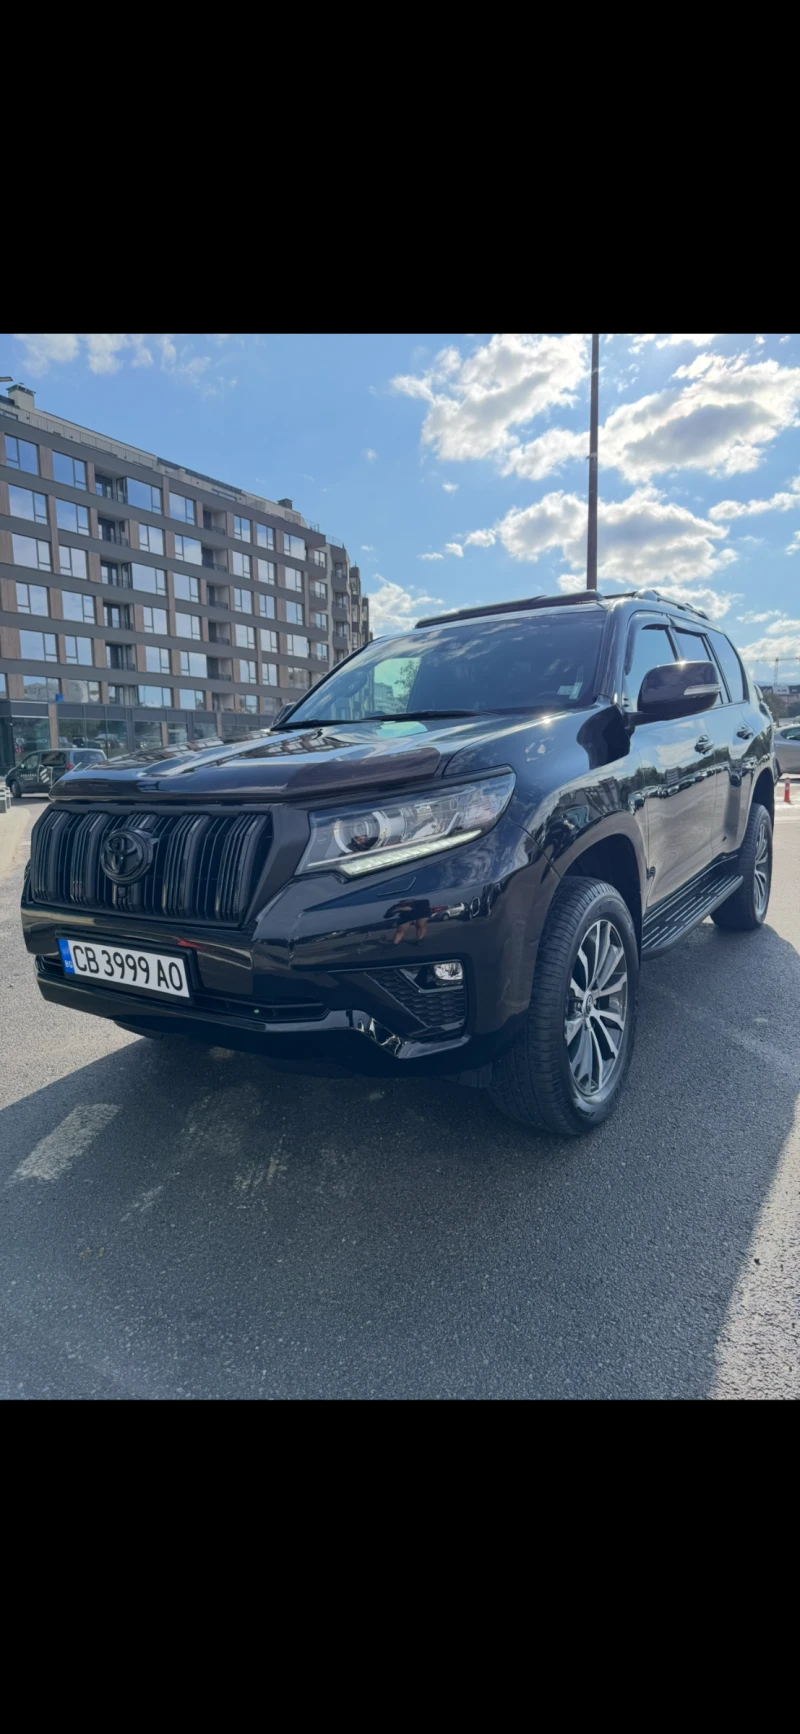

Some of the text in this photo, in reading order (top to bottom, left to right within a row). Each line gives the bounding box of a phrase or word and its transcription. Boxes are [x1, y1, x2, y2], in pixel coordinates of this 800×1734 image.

[72, 945, 183, 991] CB 3999 AO
